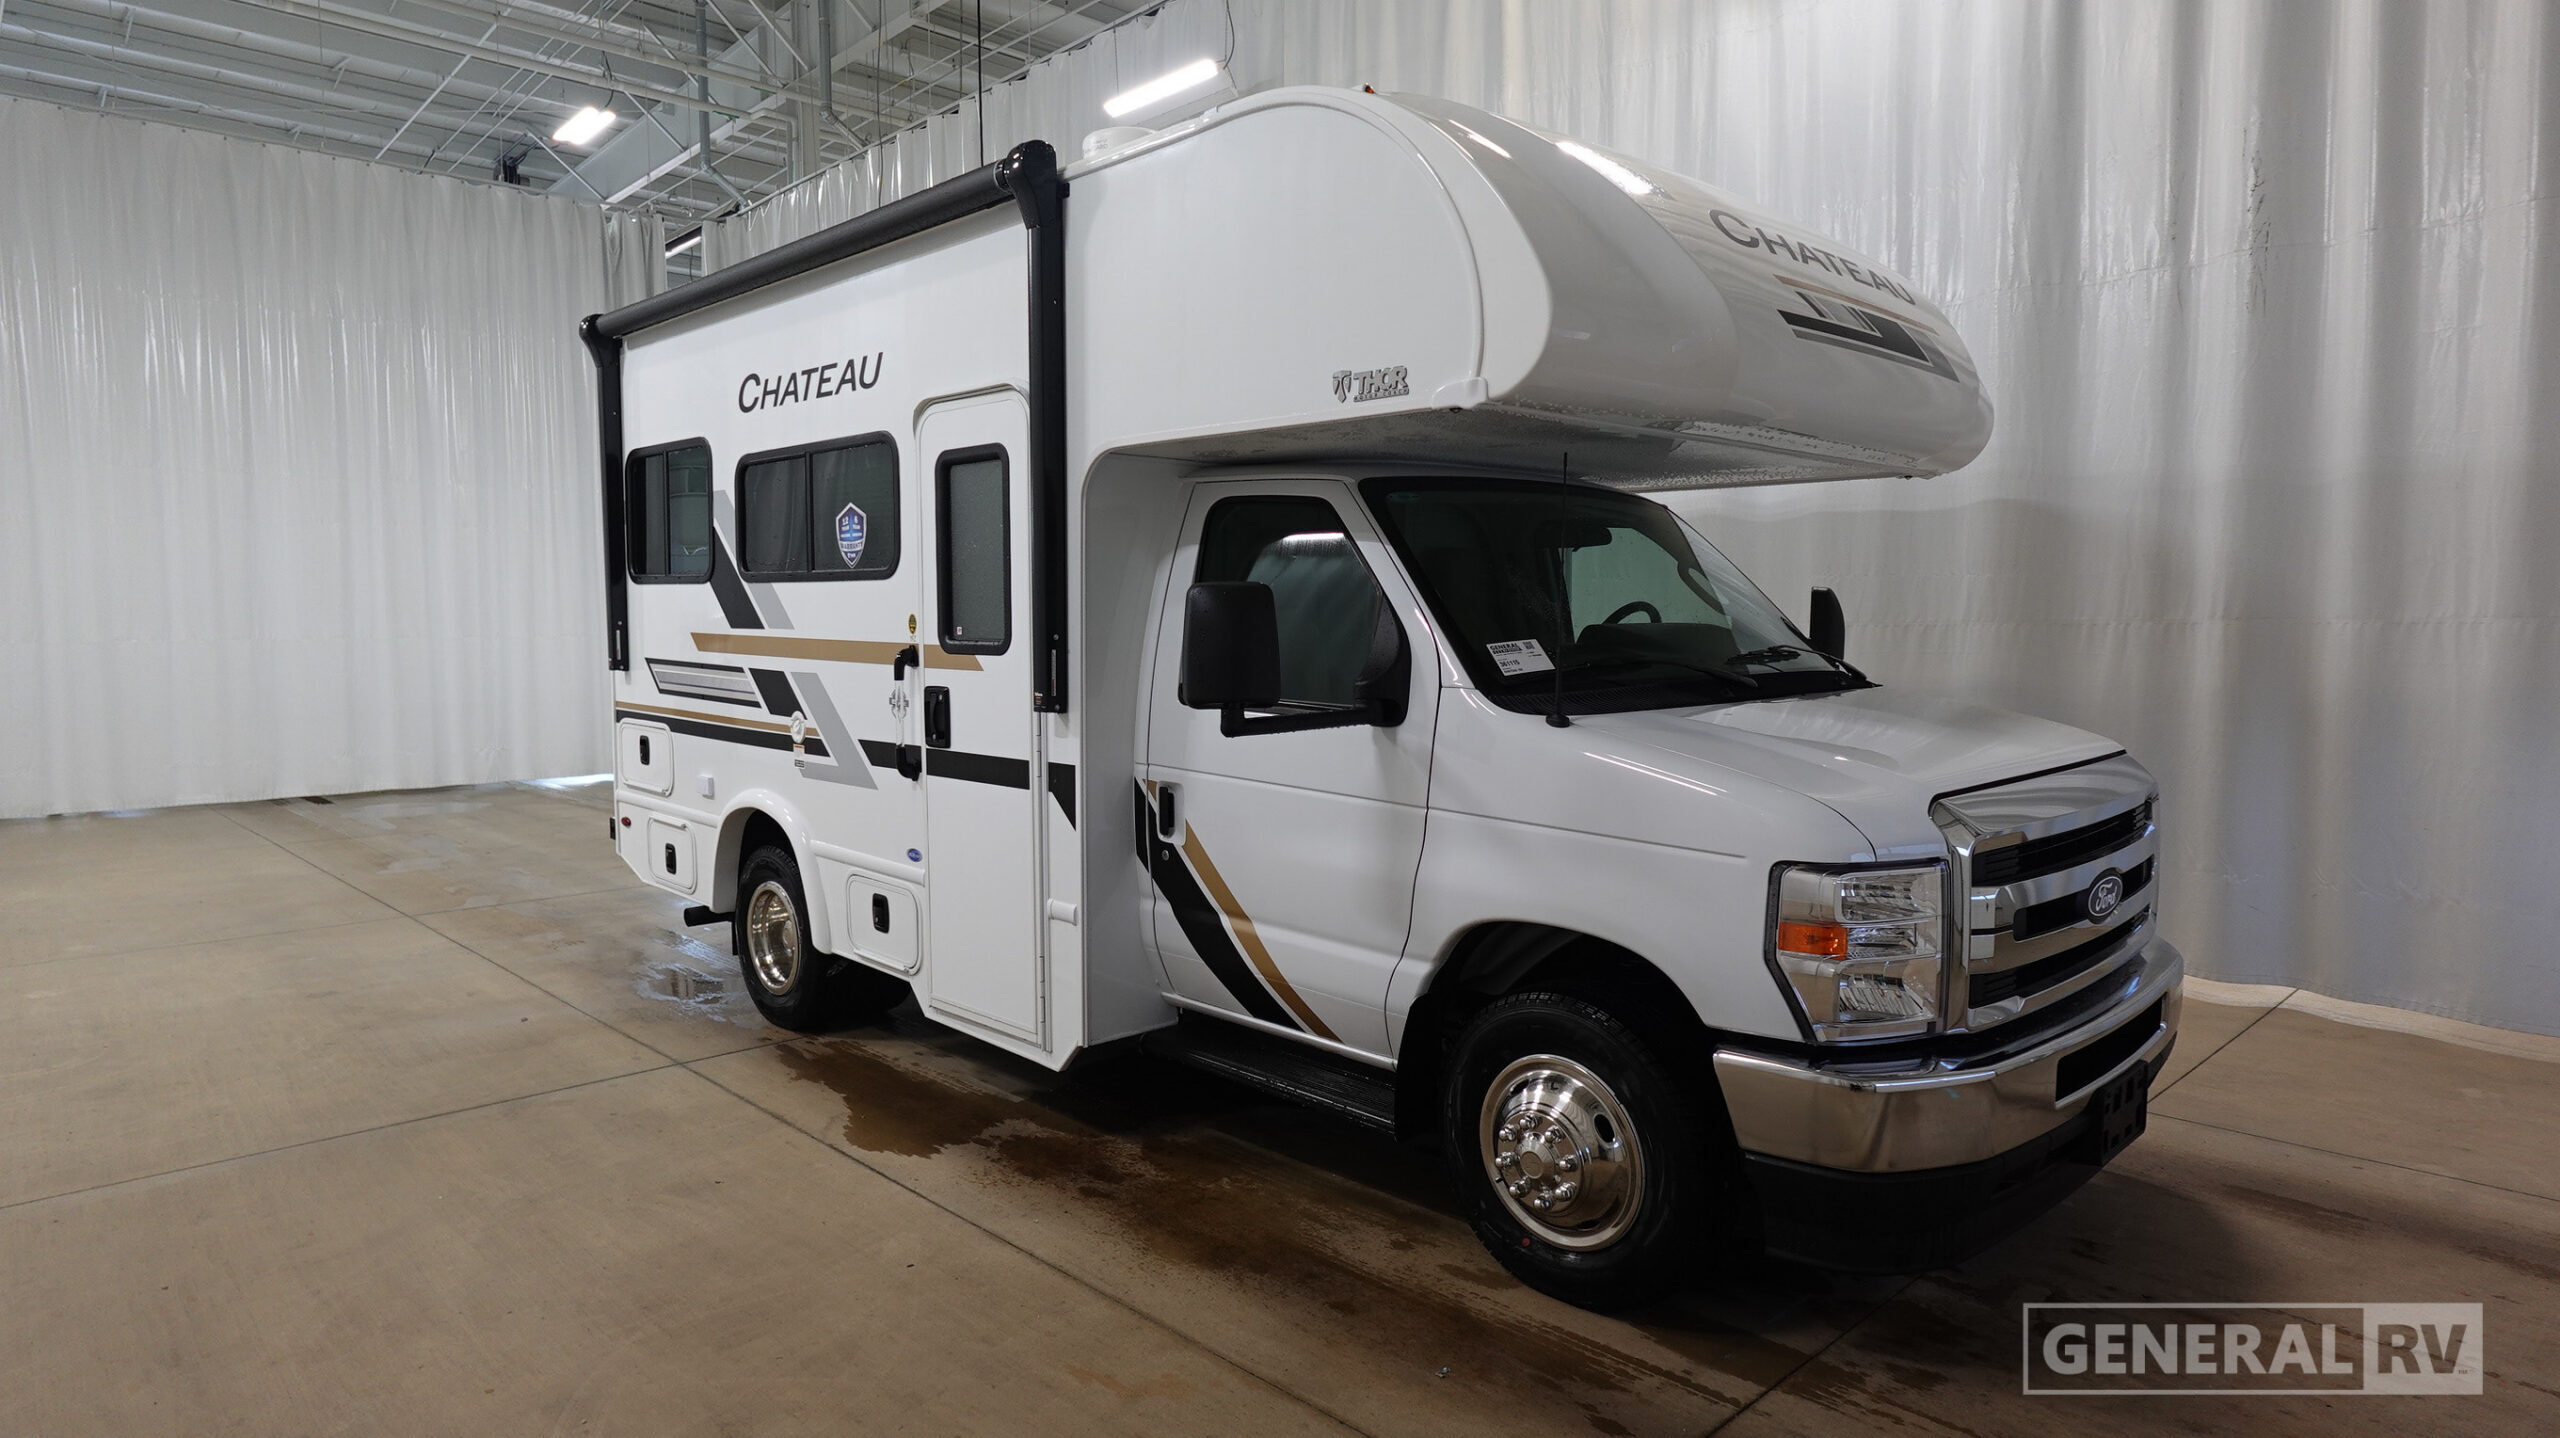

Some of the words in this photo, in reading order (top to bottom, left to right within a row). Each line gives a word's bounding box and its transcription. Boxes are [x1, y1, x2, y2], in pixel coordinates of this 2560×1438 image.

[1708, 208, 1917, 306] CHATEAU
[738, 351, 884, 414] CHATEAU
[1353, 365, 1409, 395] THOR
[2096, 882, 2117, 911] Ford
